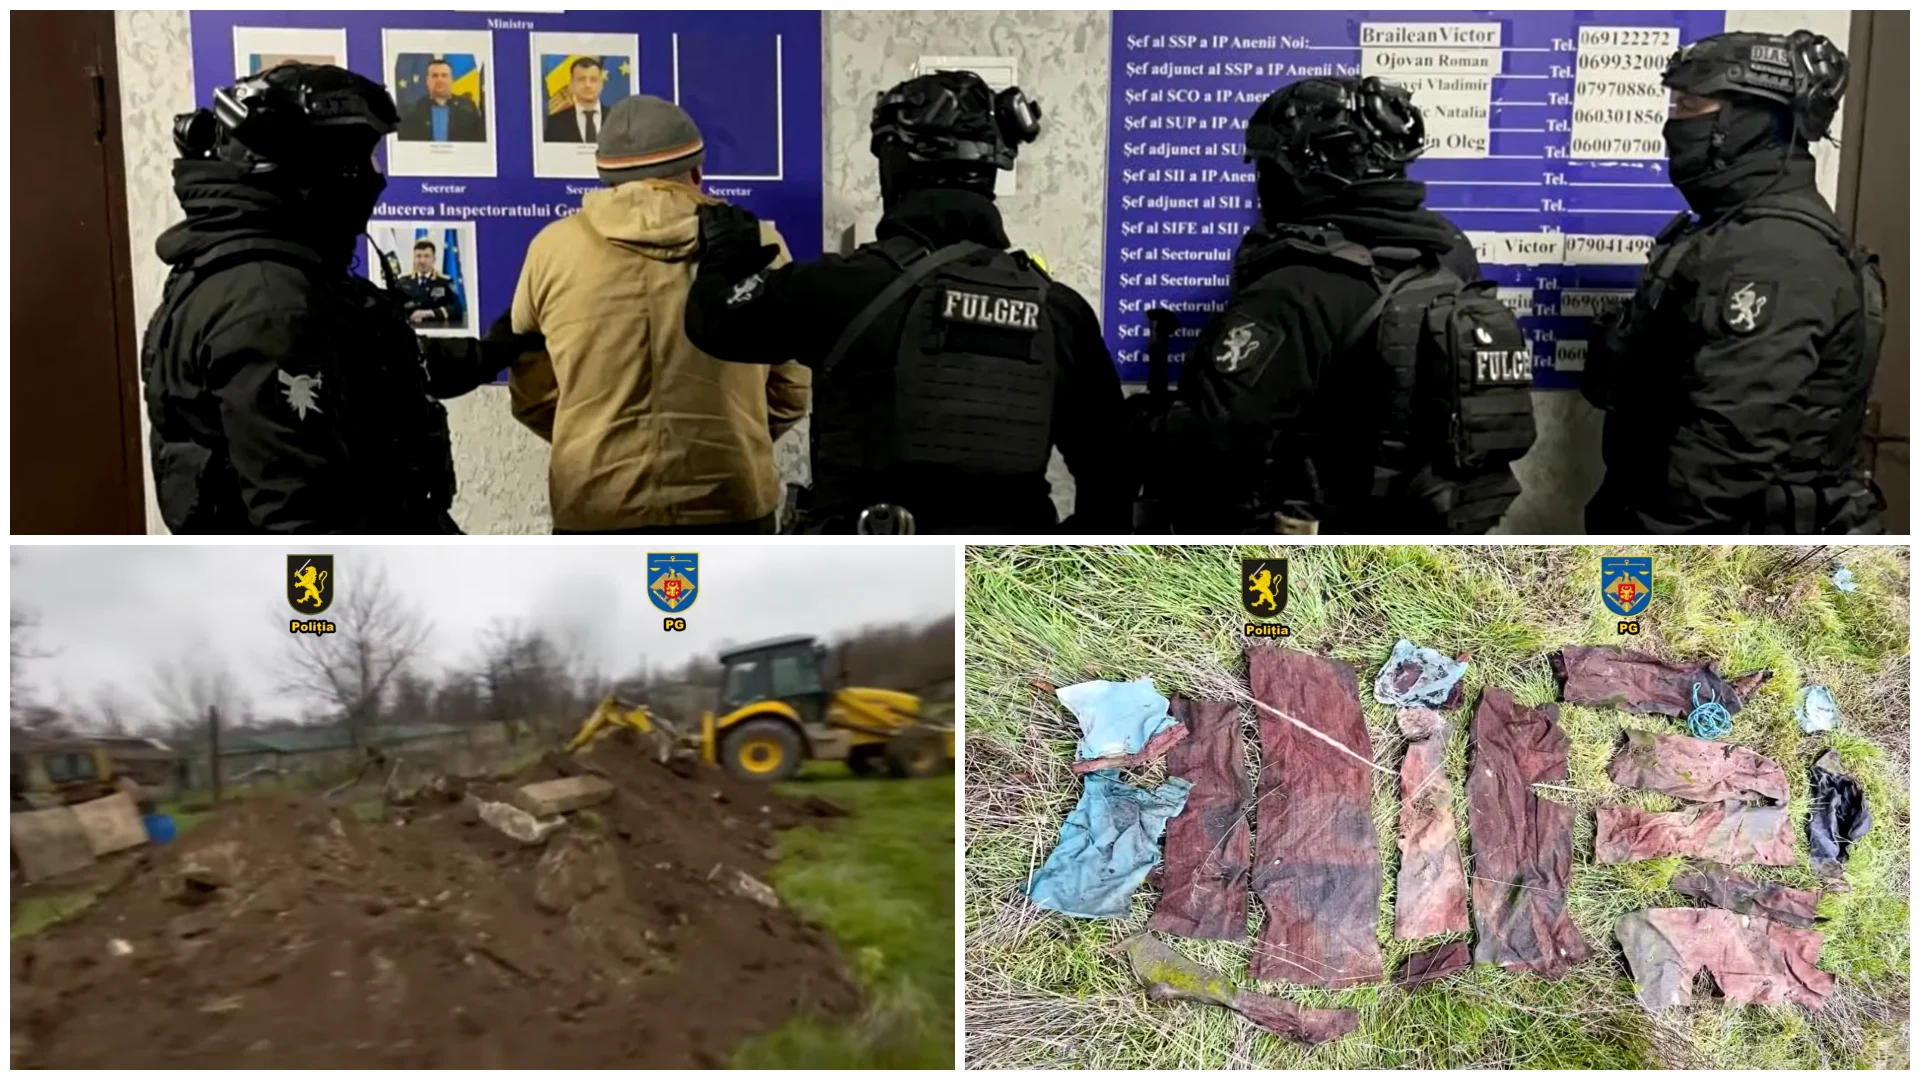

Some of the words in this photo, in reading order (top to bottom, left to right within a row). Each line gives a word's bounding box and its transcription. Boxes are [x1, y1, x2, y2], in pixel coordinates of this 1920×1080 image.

[1152, 36, 1165, 48] al
[1168, 35, 1197, 49] SSP
[1200, 38, 1208, 48] a
[1212, 35, 1228, 48] IP
[1231, 36, 1276, 49] Anenii
[1280, 36, 1310, 49] Noi:
[1551, 38, 1577, 51] Tel.
[1580, 31, 1670, 46] 069122272
[1376, 52, 1433, 69] Ojovan
[1439, 54, 1489, 67] Roman
[1151, 62, 1204, 78] adjunct
[1208, 63, 1221, 76] al
[1224, 62, 1253, 76] SSP
[1255, 66, 1263, 76] a
[1268, 63, 1284, 76] IP
[1286, 63, 1332, 76] Anenii
[1549, 65, 1575, 78] Tel.
[1427, 77, 1489, 91] Vladimir
[1150, 90, 1163, 102] al
[1167, 89, 1200, 103] SCO
[1204, 93, 1212, 102] a
[1216, 90, 1232, 103] IP
[1548, 92, 1573, 106] Tel.
[1436, 105, 1488, 118] Natalia
[1574, 109, 1664, 124] 060301856
[1149, 116, 1162, 129] al
[1166, 116, 1197, 129] SUP
[1200, 119, 1207, 129] a
[1212, 116, 1228, 129] IP
[1546, 119, 1571, 132] Tel.
[1446, 133, 1486, 151] Oleg
[1572, 138, 1662, 153] 060070700
[1149, 143, 1201, 158] adjunct
[1205, 143, 1218, 156] al
[1544, 146, 1569, 159] Tel.
[1148, 169, 1160, 182] al
[1164, 169, 1185, 182] SII
[1189, 172, 1197, 182] a
[1201, 169, 1218, 182] IP
[1542, 172, 1568, 186] Tel.
[421, 182, 467, 194] Secretar
[708, 186, 752, 197] Secretar
[1147, 195, 1199, 211] adjunct
[1203, 196, 1216, 208] al
[1219, 195, 1240, 209] SII
[1541, 199, 1567, 212] Tel.
[440, 202, 550, 220] Inspectoratului
[1146, 222, 1158, 234] al
[1162, 221, 1198, 235] SIFE
[1201, 222, 1214, 235] al
[1217, 221, 1239, 235] SII
[1505, 238, 1557, 253] Victor
[1145, 248, 1158, 260] al
[1161, 247, 1231, 261] Sectorului
[1144, 273, 1157, 286] al
[1160, 273, 1230, 287] Sectorului
[1536, 277, 1561, 291] Tel.
[943, 290, 1040, 330] FULGER
[1535, 303, 1559, 317] Tel.
